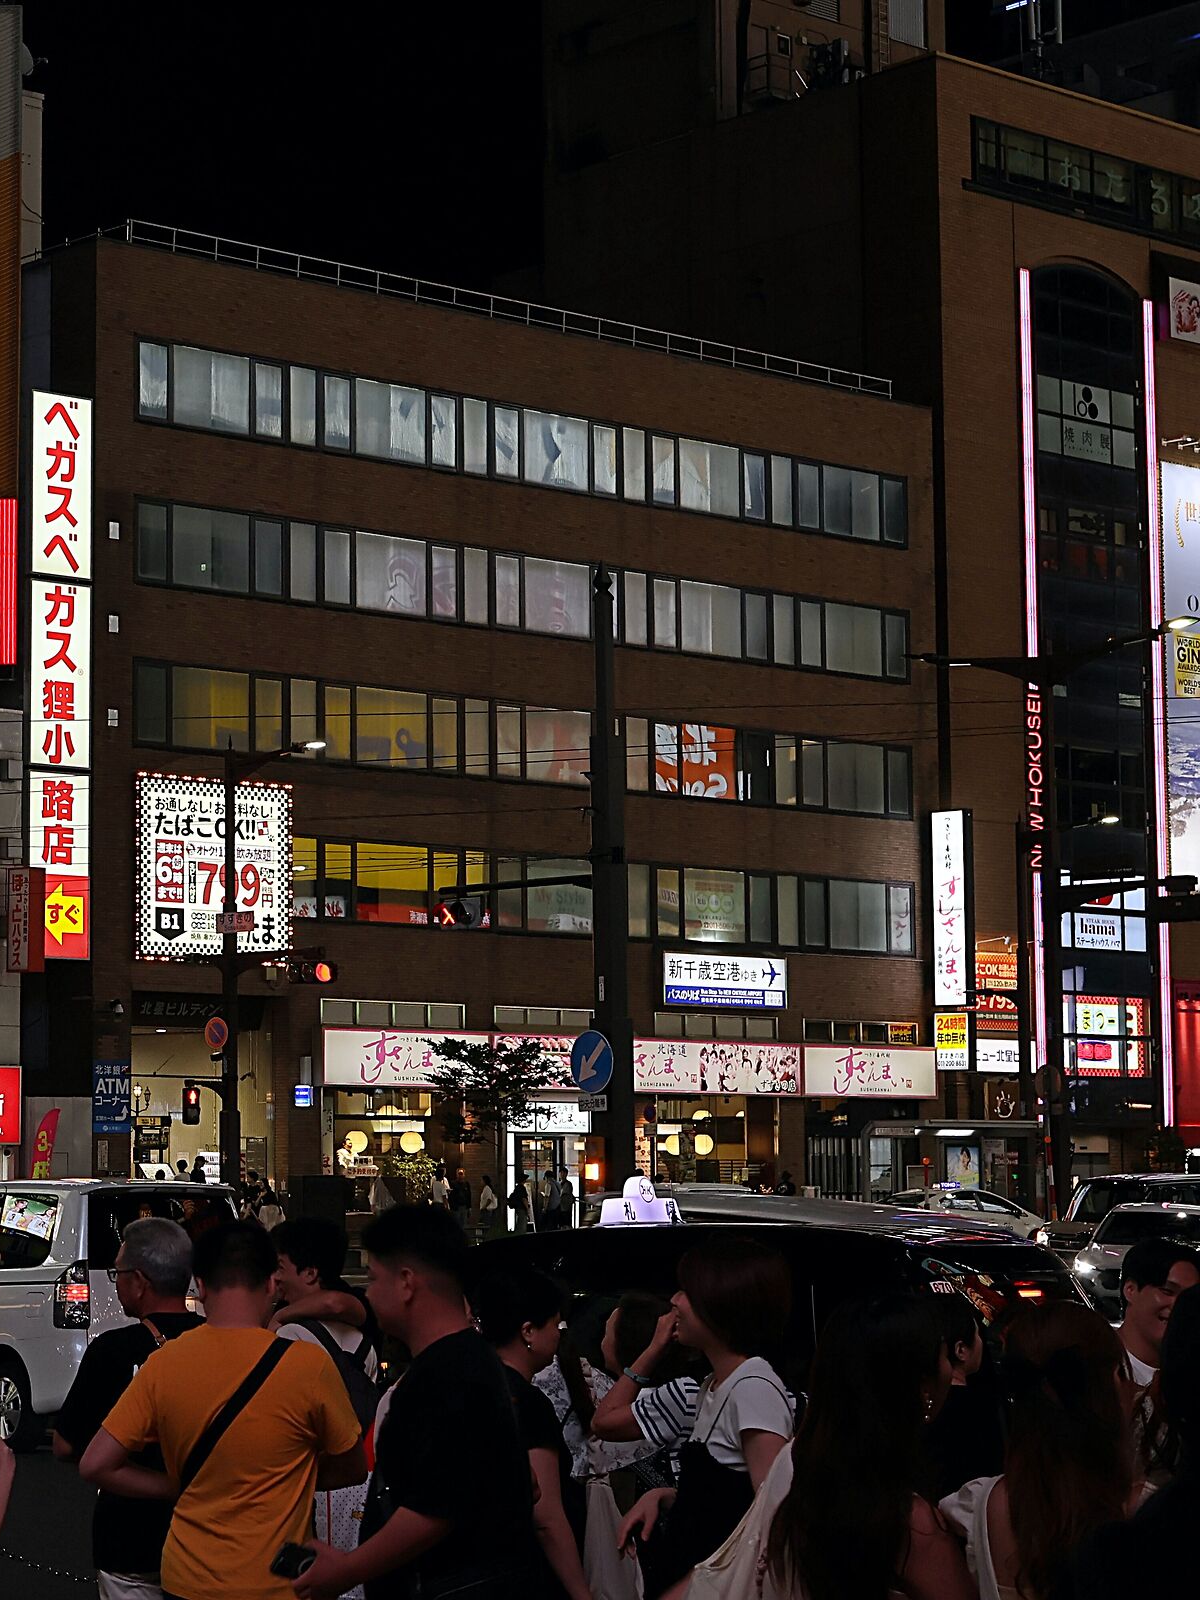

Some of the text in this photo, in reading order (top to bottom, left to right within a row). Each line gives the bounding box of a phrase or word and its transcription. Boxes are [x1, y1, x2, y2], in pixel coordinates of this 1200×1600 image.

[1177, 647, 1200, 662] GIN
[1184, 686, 1196, 694] BEST
[1027, 689, 1043, 807] HOKUSEI
[214, 801, 274, 818] お料なし!
[261, 894, 274, 908] 円
[47, 903, 80, 925] すぐ
[160, 913, 180, 930] B1
[1080, 917, 1116, 936] hama
[668, 958, 758, 983] 新千歳空港ゆき
[667, 988, 700, 1001] バスのりば
[140, 1000, 224, 1016] 北星ビルディン
[937, 1017, 966, 1031] 24時間
[937, 1032, 966, 1045] 年中無休
[360, 1032, 441, 1084] すしざんま
[657, 1043, 688, 1058] 北海道
[634, 1044, 689, 1082] ざんまい
[833, 1048, 905, 1094] すしざんまい
[95, 1079, 130, 1095] ATM
[95, 1096, 130, 1106] コーナー
